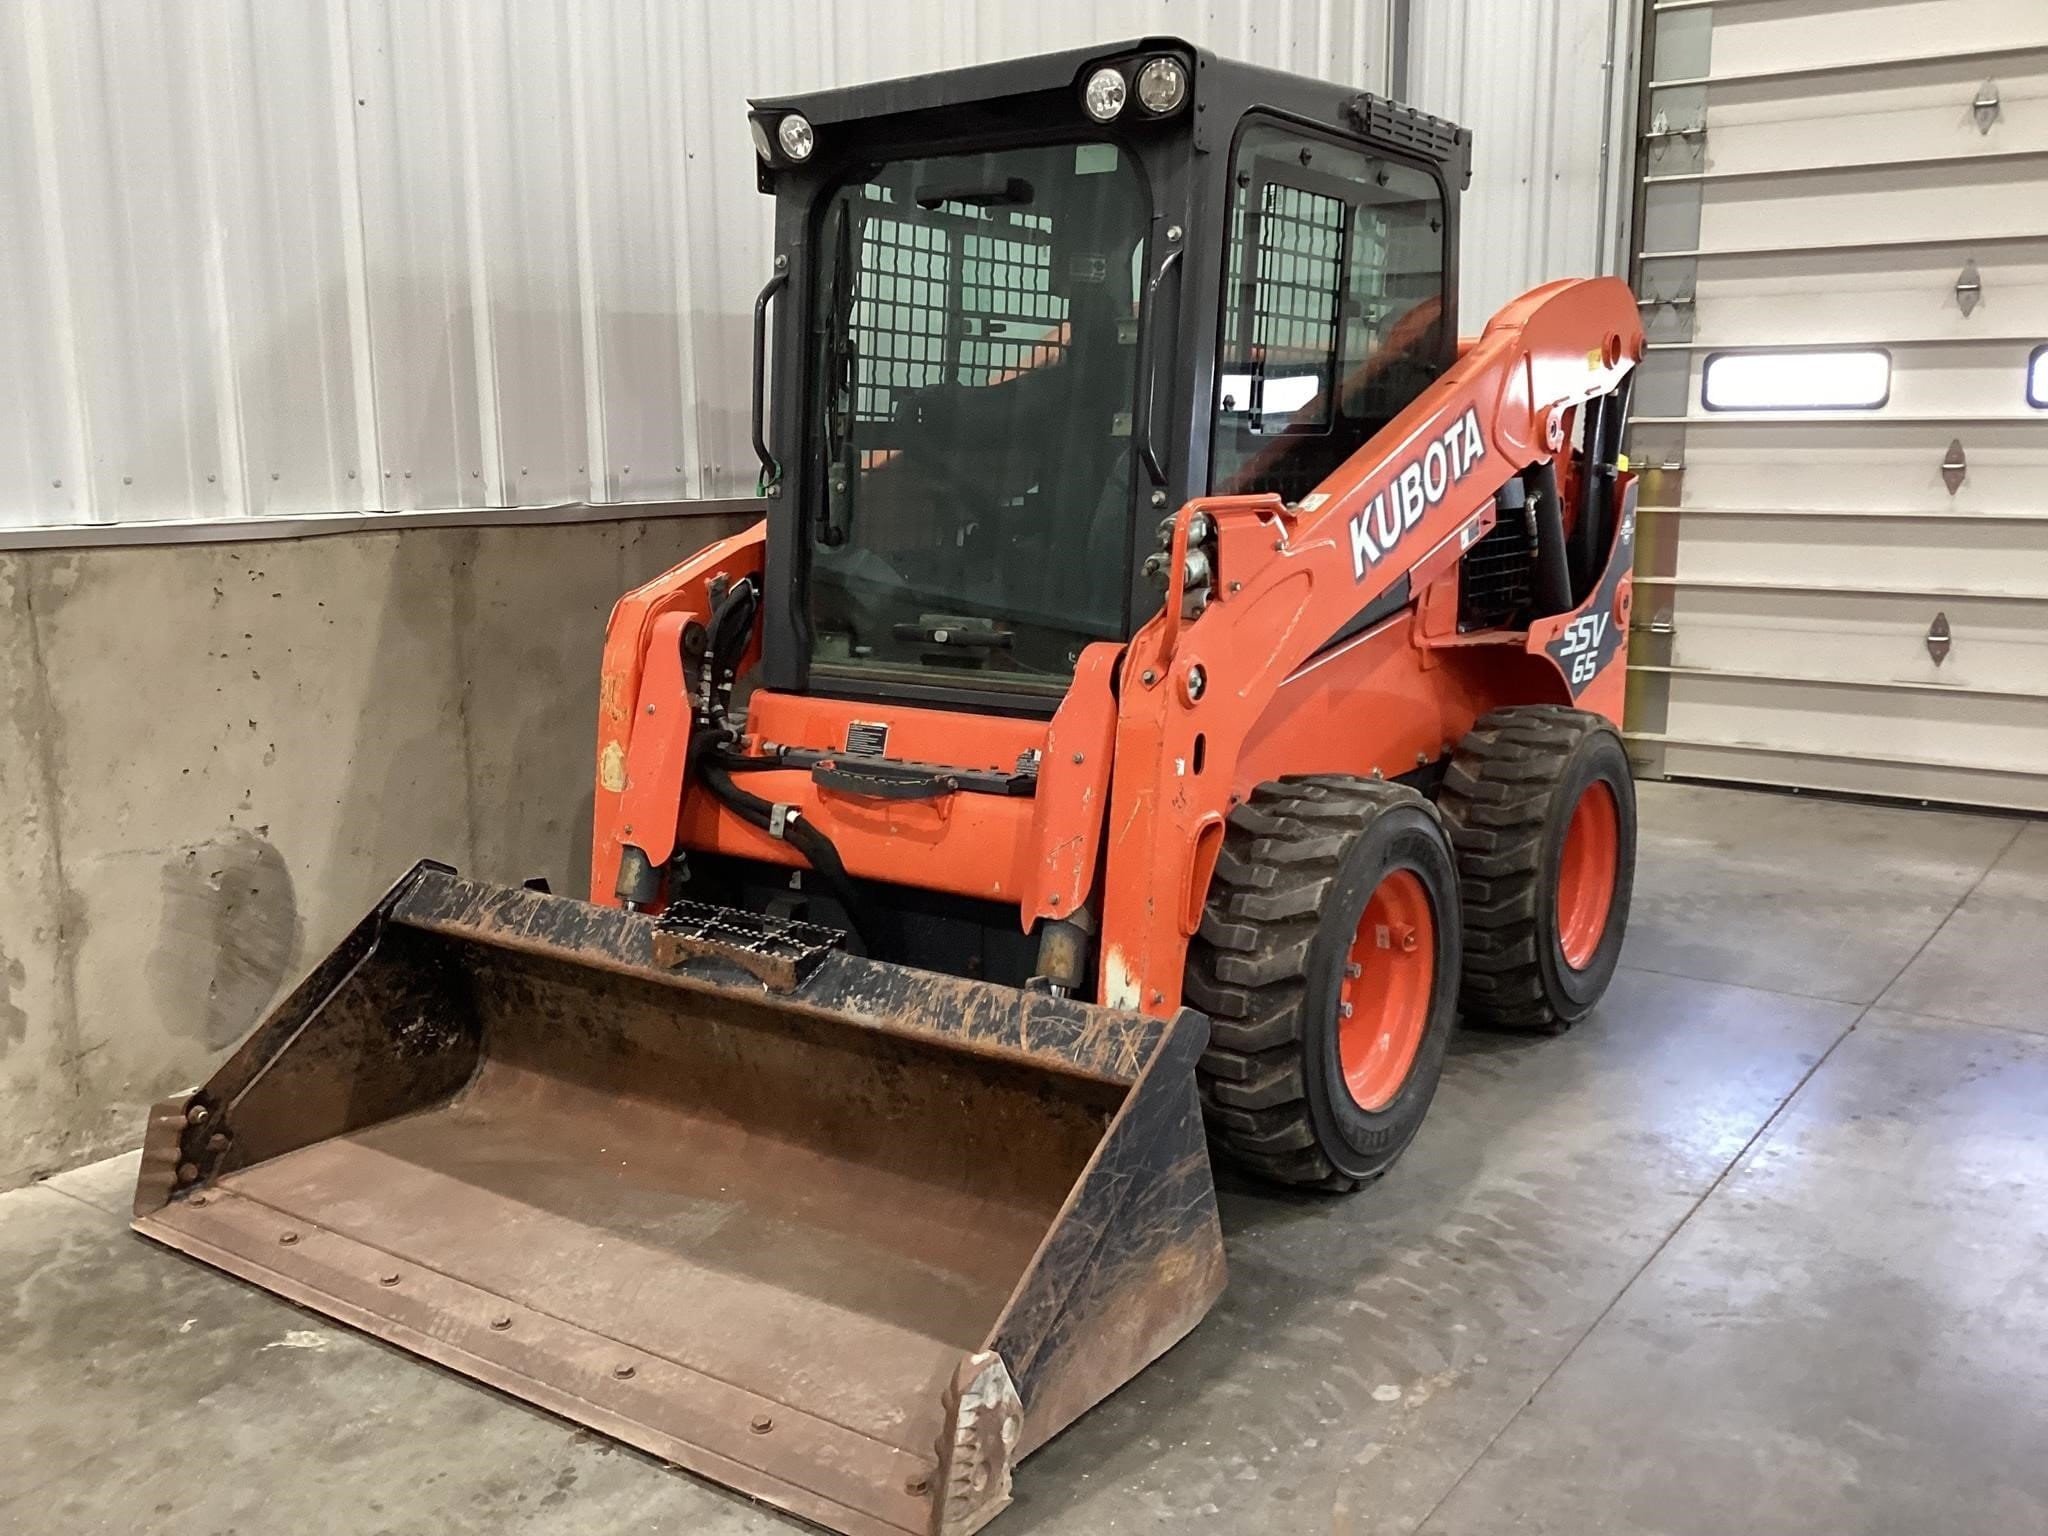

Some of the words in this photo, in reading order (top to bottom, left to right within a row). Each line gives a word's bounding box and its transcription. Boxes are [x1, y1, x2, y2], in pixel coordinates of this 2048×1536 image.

[1349, 408, 1486, 579] KUBOTA
[1560, 611, 1610, 656] SSV
[1572, 650, 1598, 684] 65
